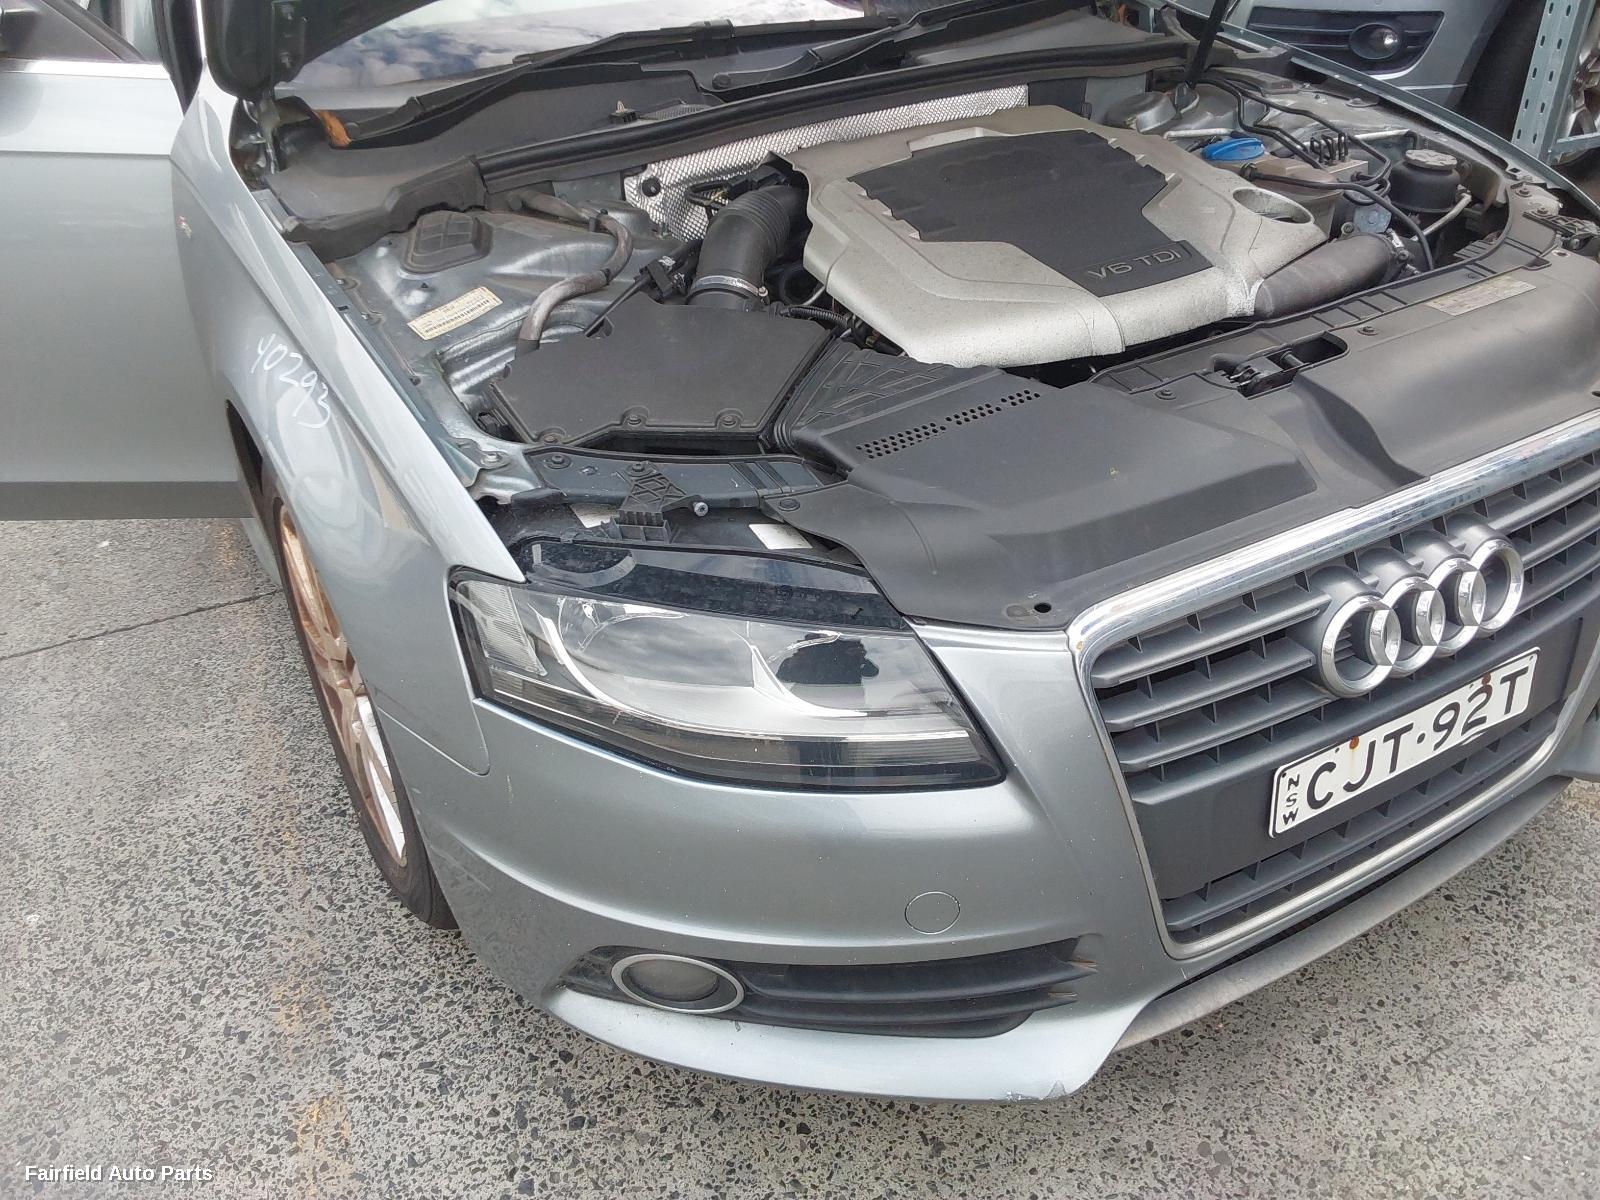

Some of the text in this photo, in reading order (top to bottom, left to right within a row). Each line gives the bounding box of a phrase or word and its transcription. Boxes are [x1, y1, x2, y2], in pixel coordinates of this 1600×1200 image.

[1087, 249, 1182, 279] V6 TDI
[1282, 774, 1300, 826] NSW
